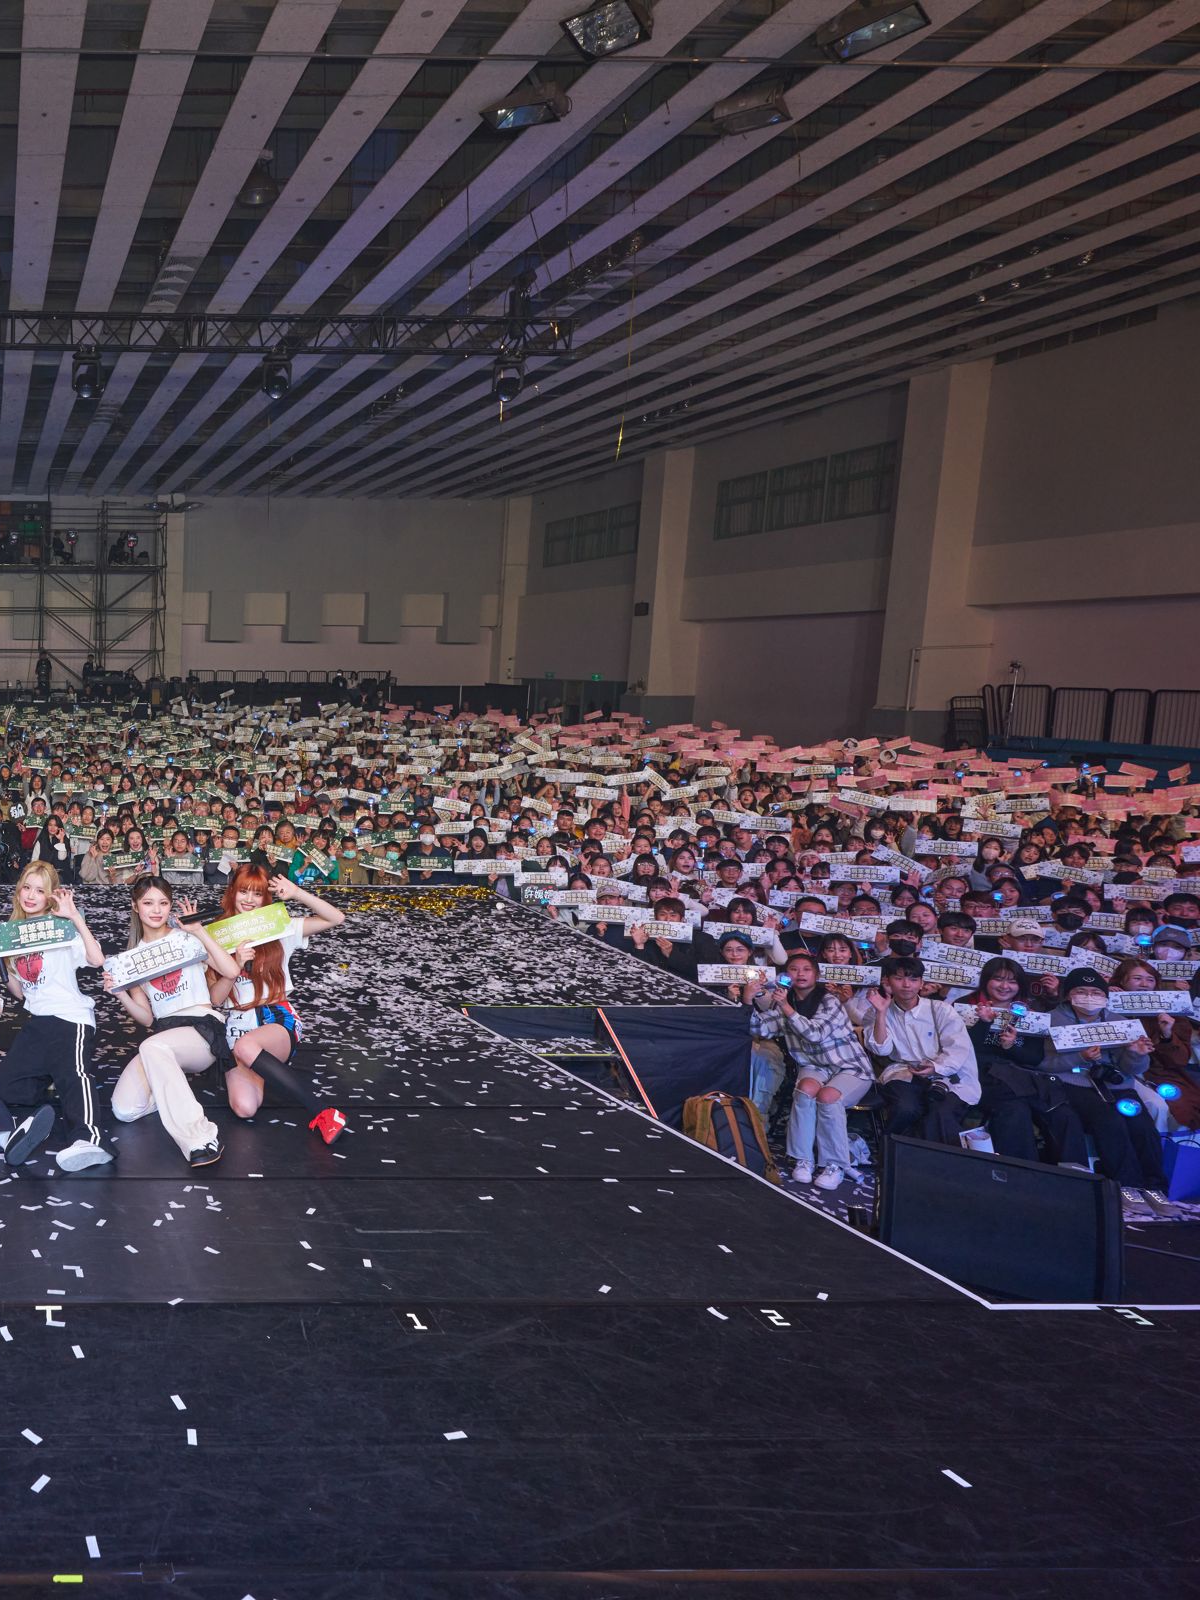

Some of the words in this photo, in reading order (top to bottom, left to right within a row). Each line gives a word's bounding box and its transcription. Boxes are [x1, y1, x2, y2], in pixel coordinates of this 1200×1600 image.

[18, 920, 55, 934] 肩並著肩
[12, 929, 65, 944] 一起走向未來
[131, 942, 172, 964] 肩並著肩
[127, 949, 185, 975] 一起走向未來
[154, 981, 189, 1002] Concert!
[161, 979, 177, 990] Fan
[406, 1313, 428, 1330] 1
[760, 1309, 791, 1326] 2
